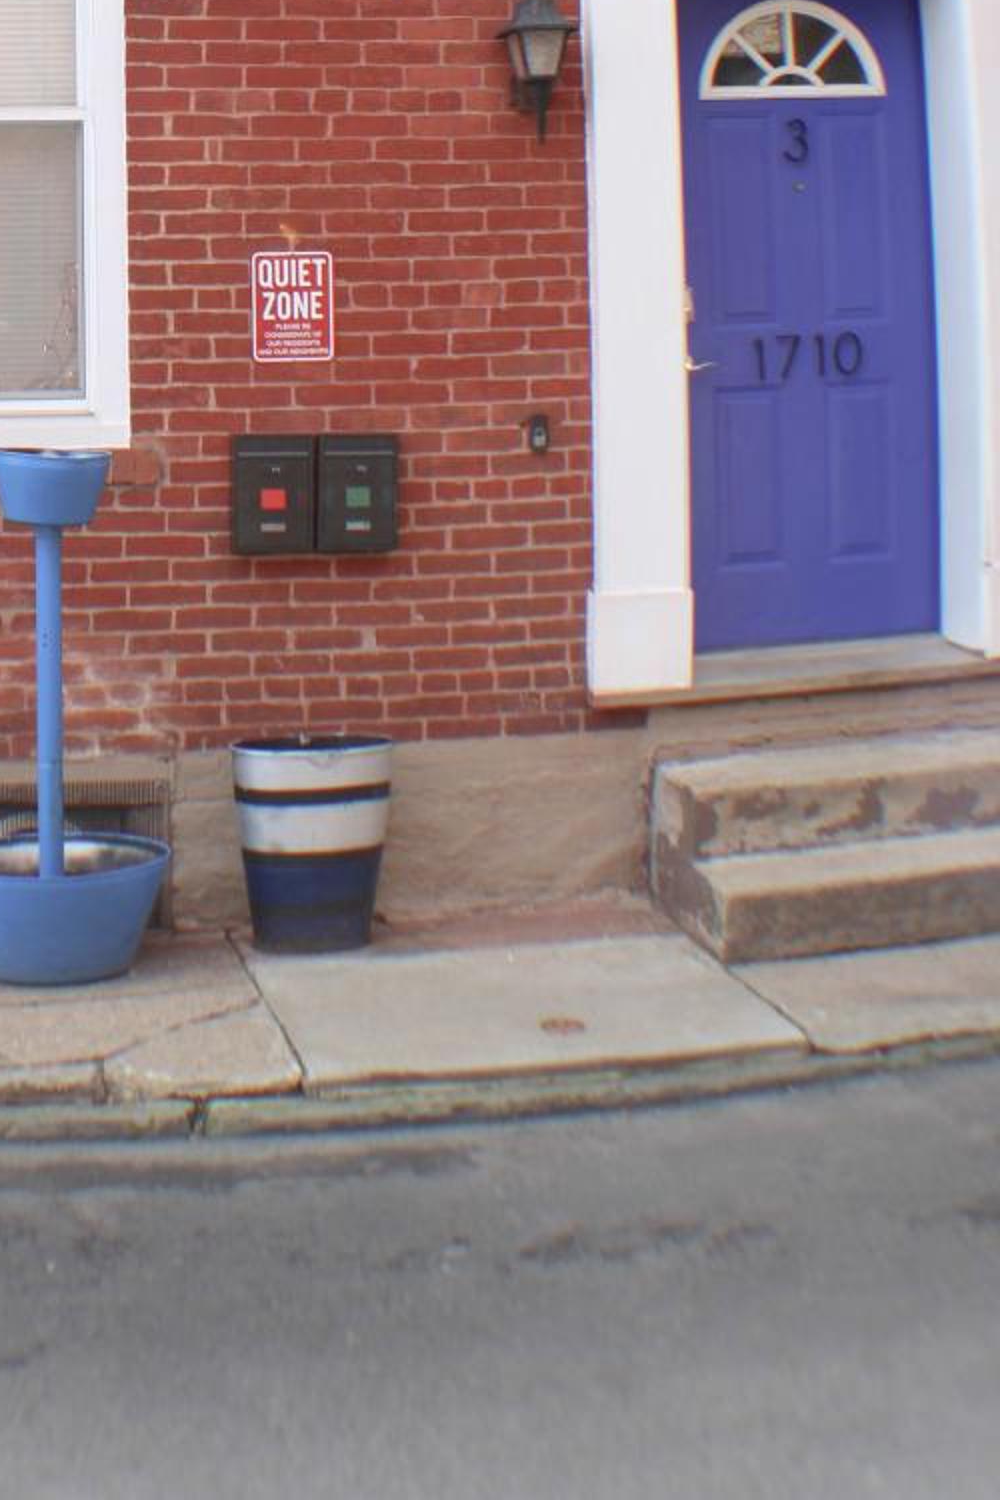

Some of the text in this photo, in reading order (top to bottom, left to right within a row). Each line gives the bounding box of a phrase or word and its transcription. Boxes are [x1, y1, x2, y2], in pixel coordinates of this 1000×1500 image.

[783, 117, 809, 164] 3
[258, 258, 327, 290] QUIET
[262, 291, 325, 321] ZONE
[752, 330, 863, 381] 1710
